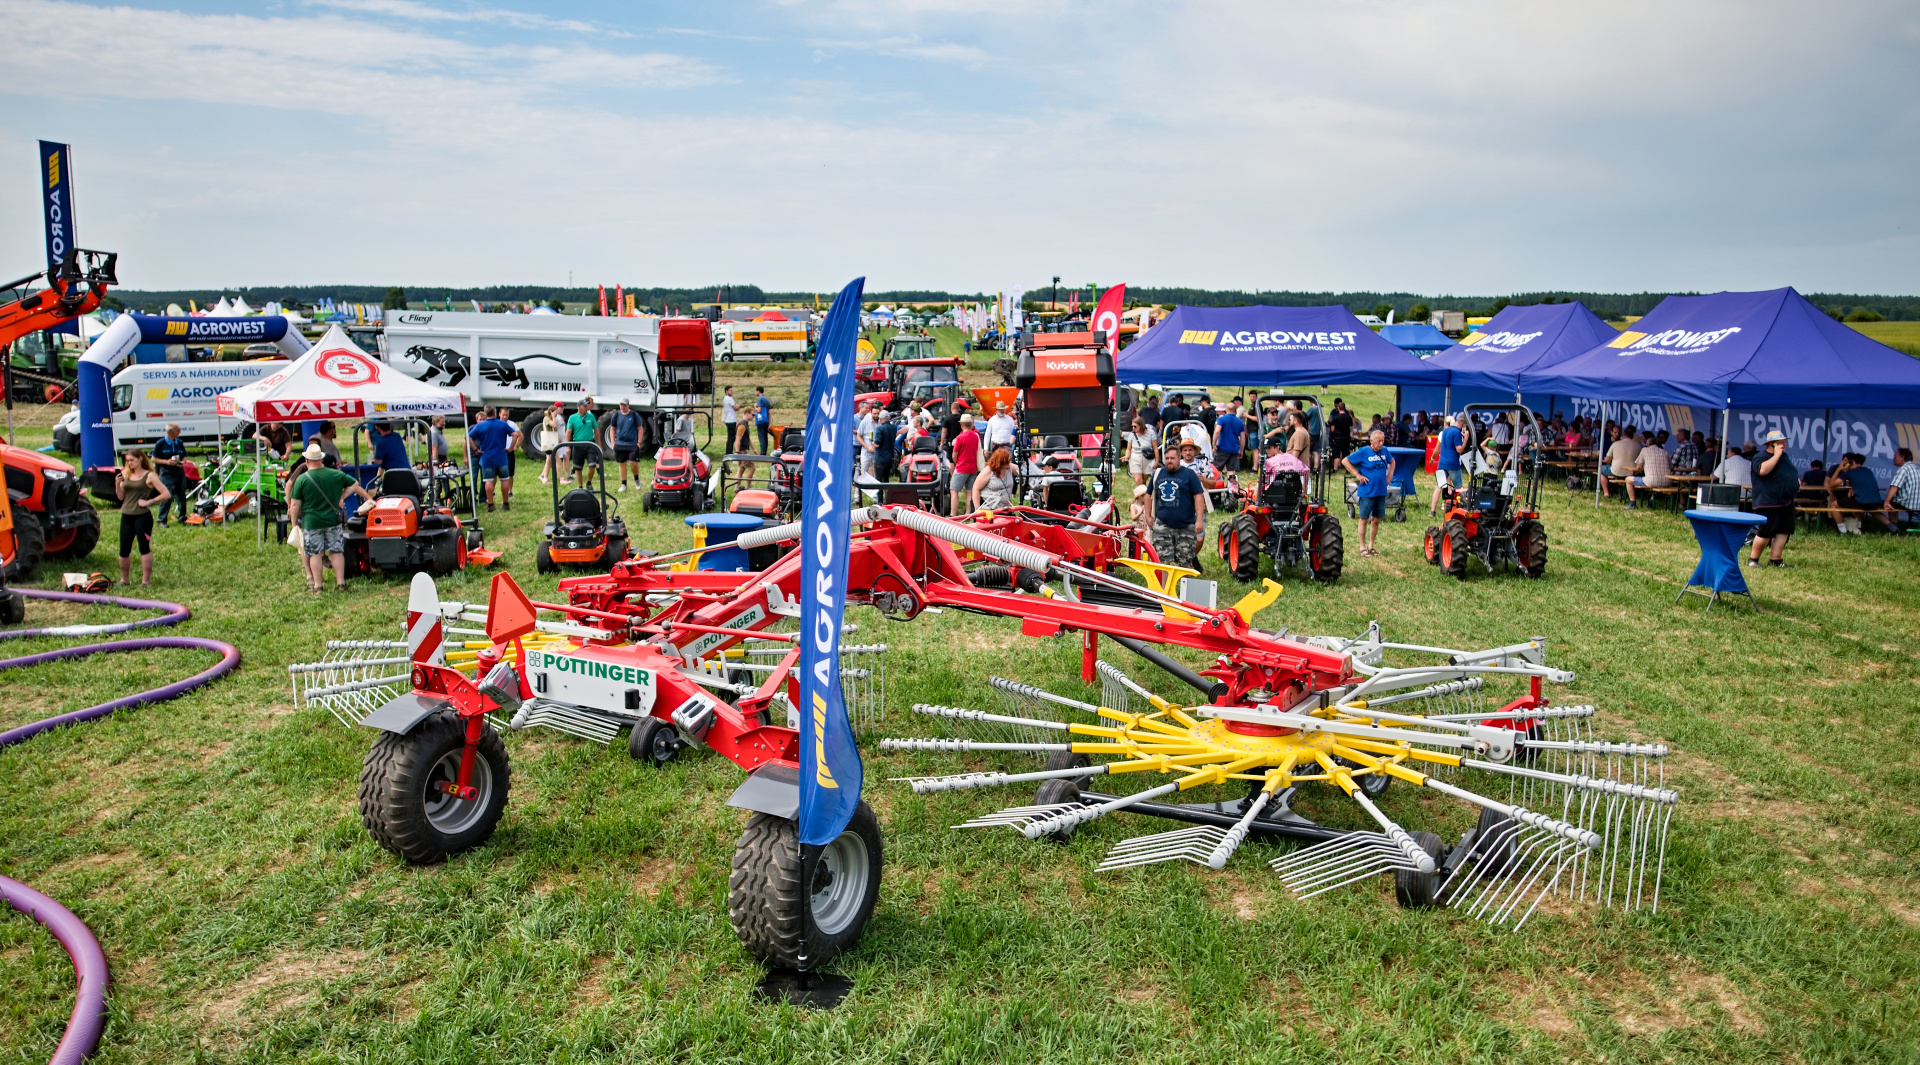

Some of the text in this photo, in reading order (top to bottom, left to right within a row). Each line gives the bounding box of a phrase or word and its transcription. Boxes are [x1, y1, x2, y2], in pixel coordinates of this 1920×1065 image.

[190, 321, 265, 335] AGROWEST
[1220, 331, 1357, 346] AGROWEST
[337, 363, 358, 375] 5
[1046, 361, 1086, 370] Kubota
[143, 371, 178, 380] SERVIS
[189, 367, 240, 379] NÁHRADNÍ
[242, 366, 262, 376] DÍLY
[534, 381, 559, 391] RIGHT
[271, 400, 356, 417] VARI
[389, 403, 437, 412] AGROWEST
[543, 653, 650, 686] PÖTTINGER
